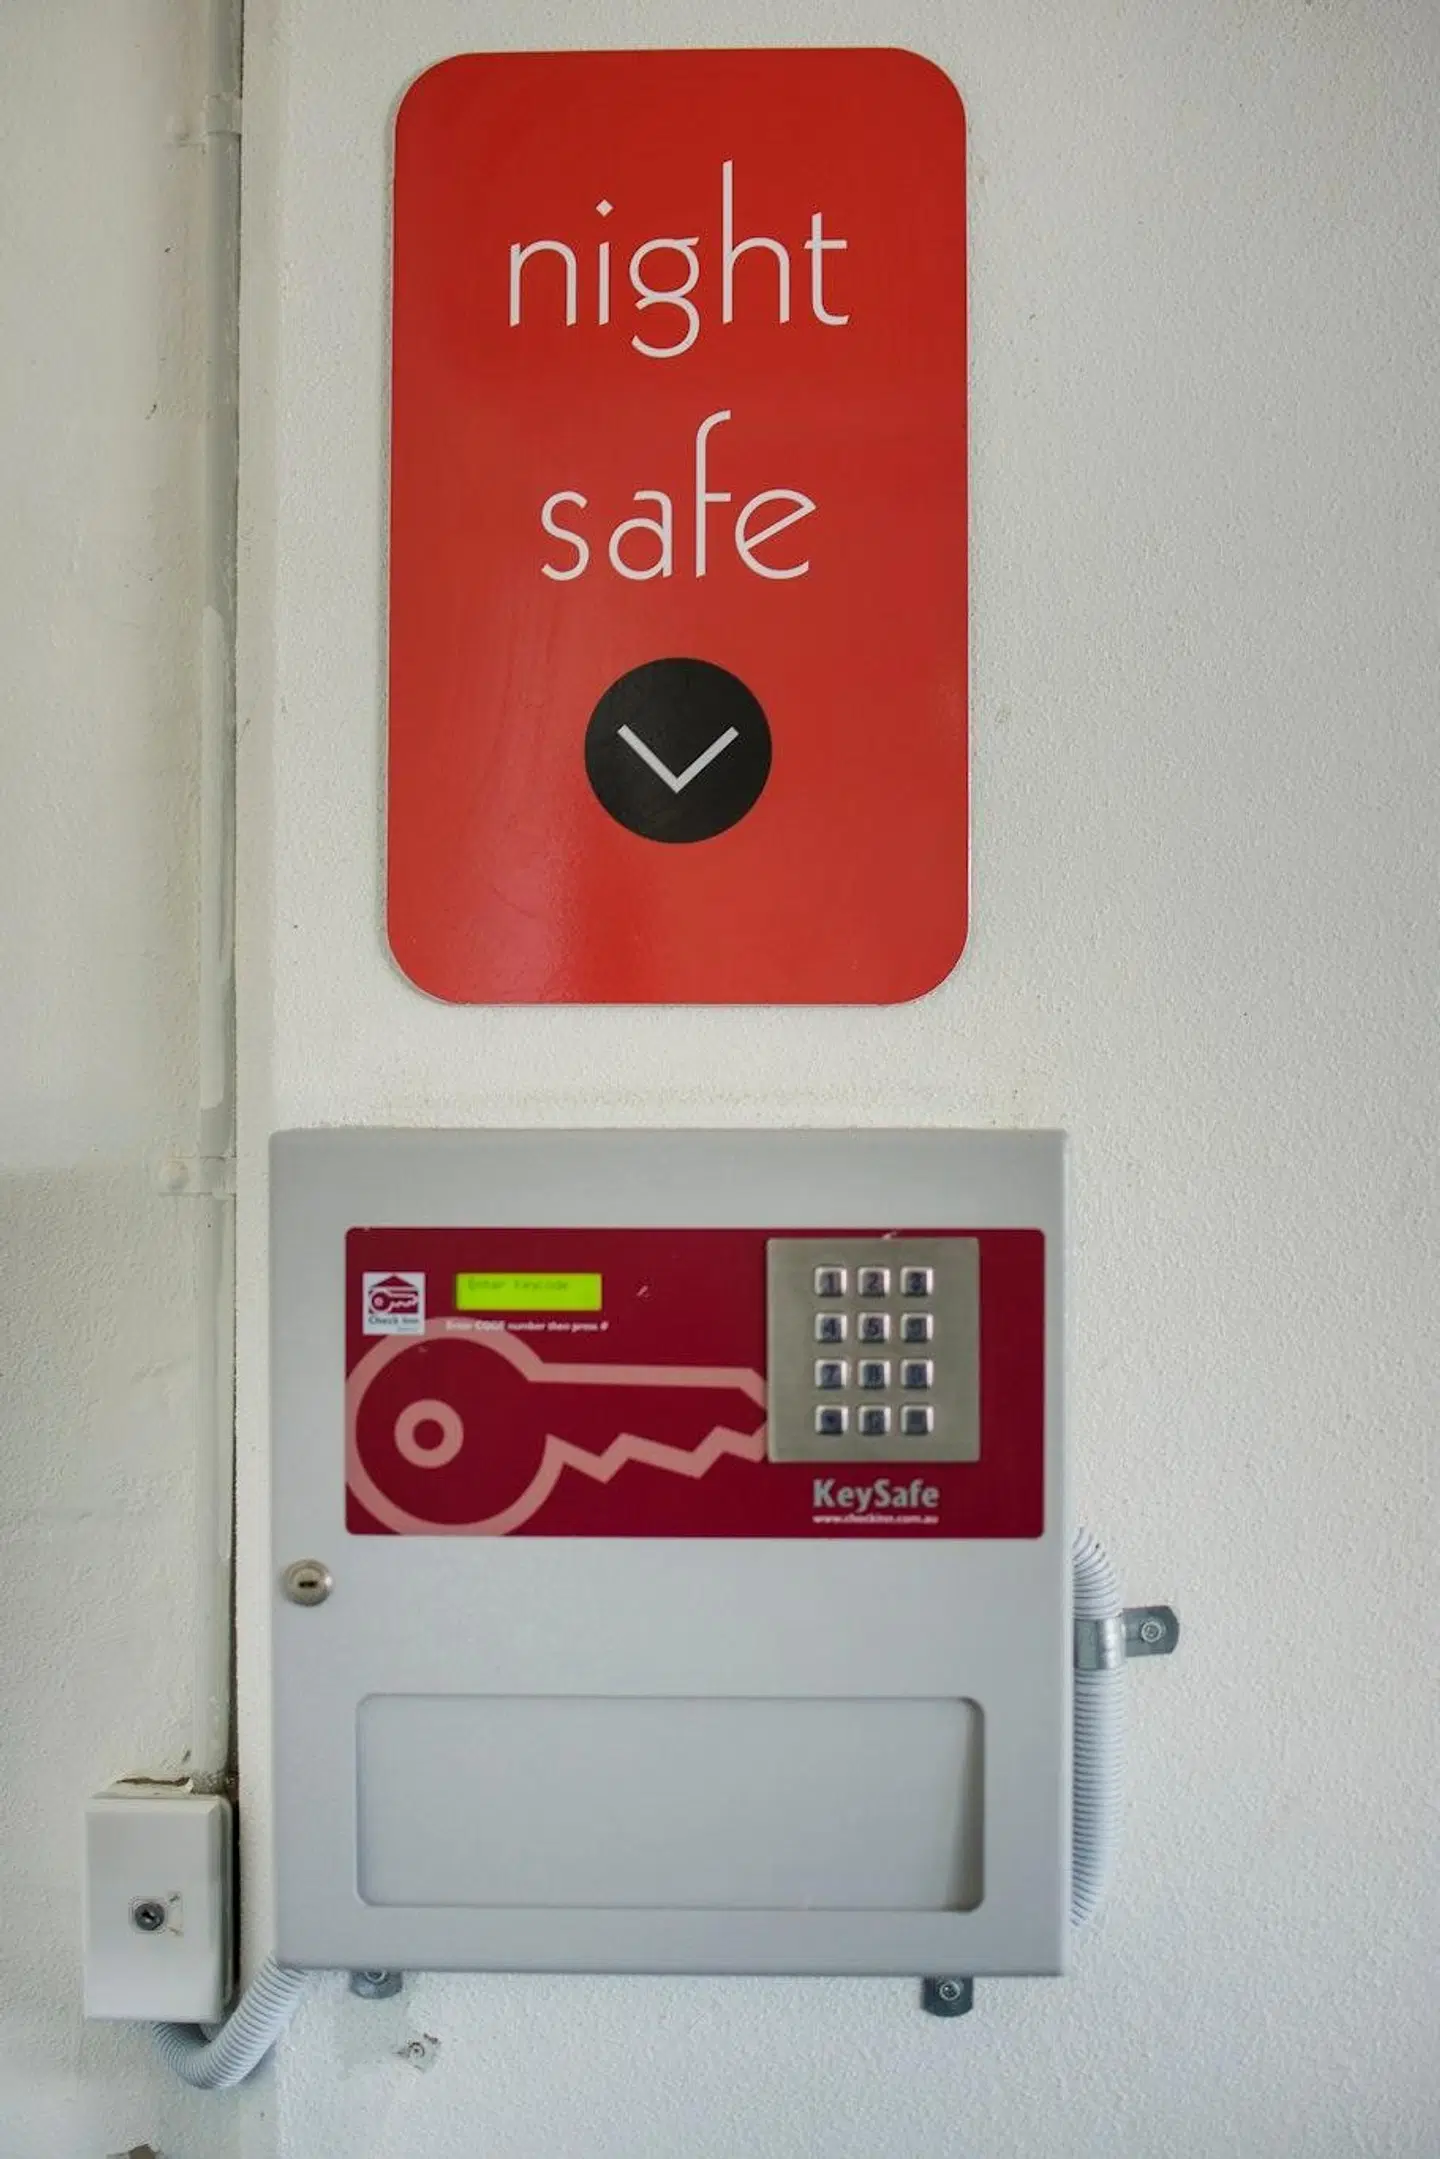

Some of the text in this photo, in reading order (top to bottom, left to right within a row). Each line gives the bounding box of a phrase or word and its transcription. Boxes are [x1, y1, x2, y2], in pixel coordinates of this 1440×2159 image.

[509, 160, 851, 359] night
[541, 410, 817, 582] safe
[507, 1320, 546, 1331] number
[547, 1320, 571, 1332] then
[571, 1322, 599, 1333] press
[812, 1478, 941, 1513] KeySafe
[812, 1514, 940, 1525] www.checkinn.com.au
